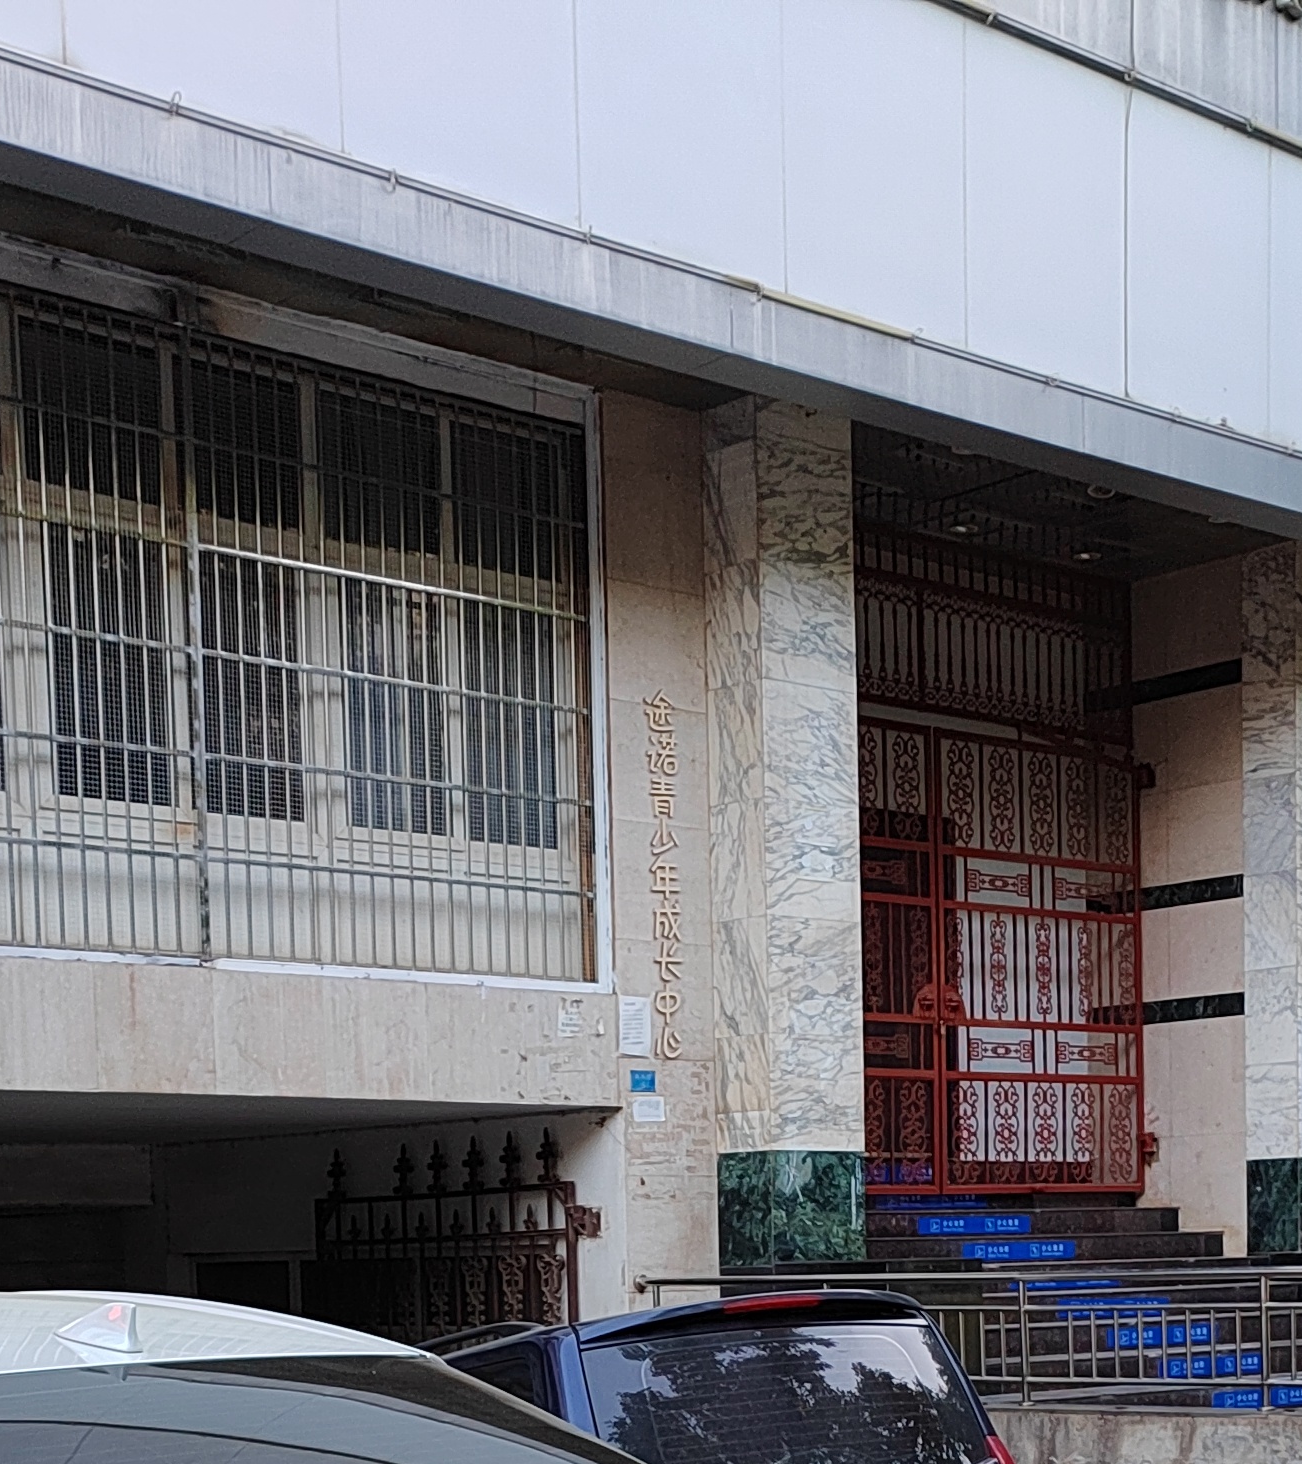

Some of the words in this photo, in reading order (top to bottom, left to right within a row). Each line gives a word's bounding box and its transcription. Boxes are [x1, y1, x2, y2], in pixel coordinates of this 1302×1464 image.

[643, 689, 683, 1059] 途诺青少年成长中心
